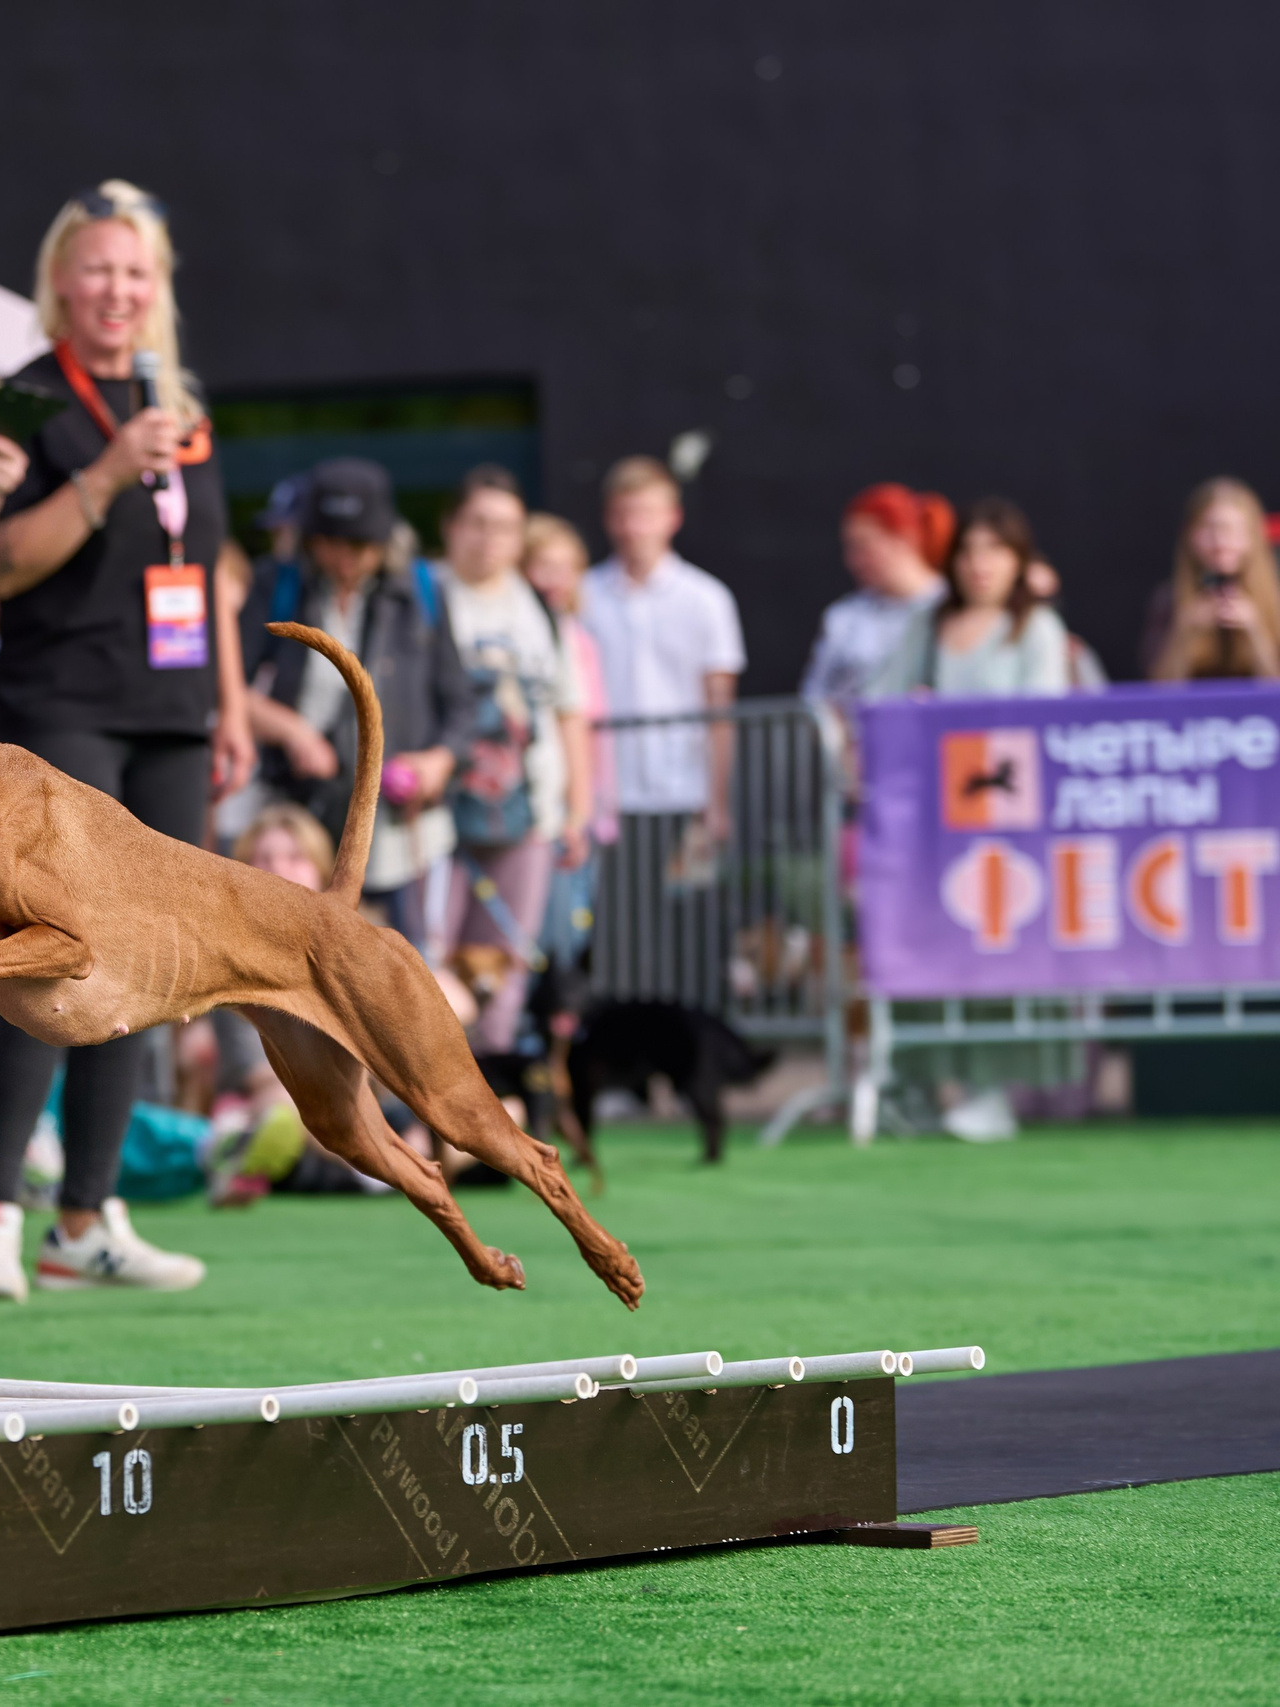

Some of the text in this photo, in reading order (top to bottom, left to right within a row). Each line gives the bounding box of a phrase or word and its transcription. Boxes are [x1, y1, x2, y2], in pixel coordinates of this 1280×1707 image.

[941, 829, 1278, 952] ФЕСТ
[461, 1422, 525, 1486] 0.5
[830, 1395, 855, 1455] 0
